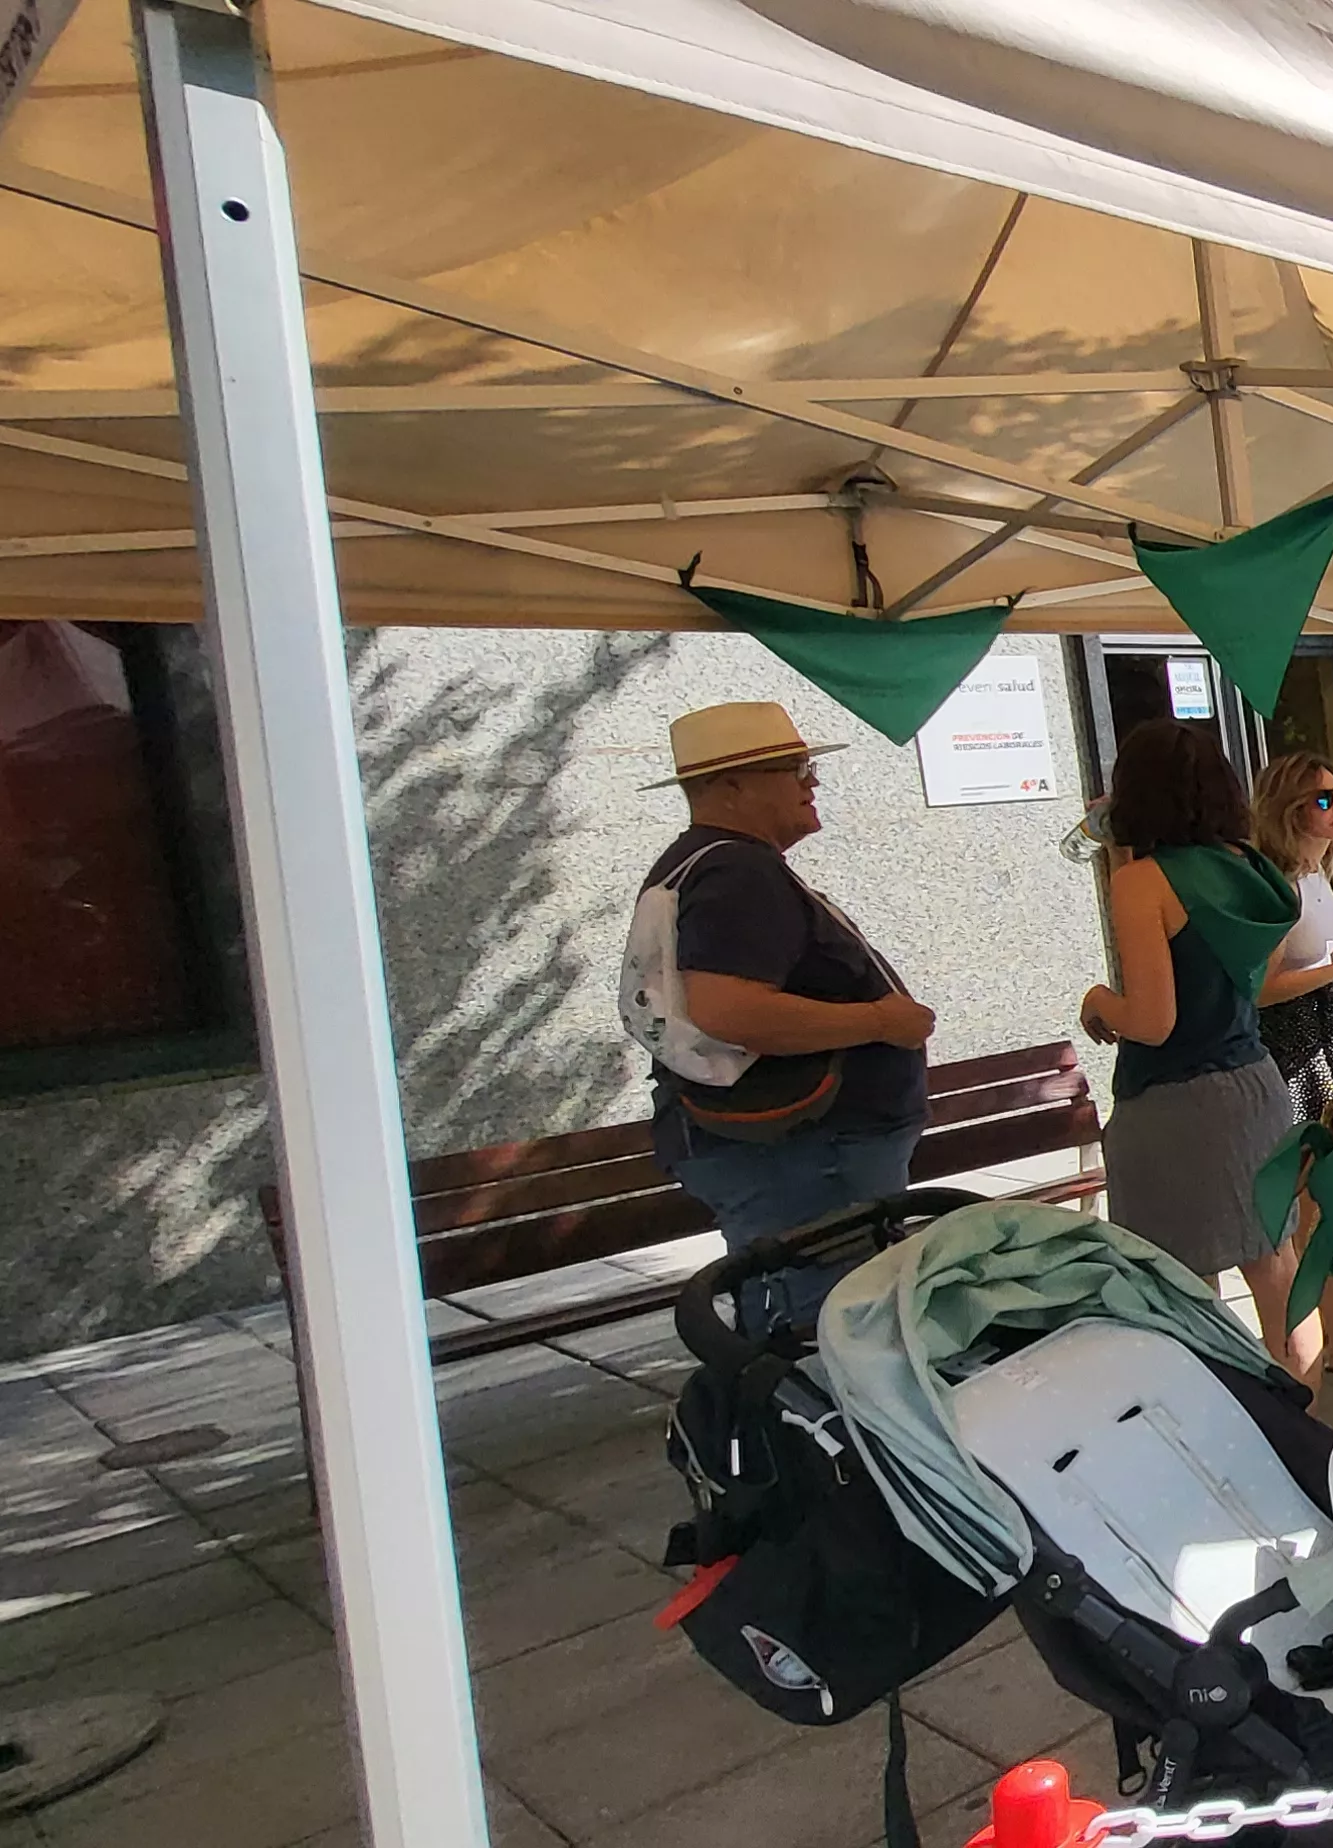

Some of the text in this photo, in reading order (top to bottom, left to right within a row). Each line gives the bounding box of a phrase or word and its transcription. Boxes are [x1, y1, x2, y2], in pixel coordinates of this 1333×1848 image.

[997, 679, 1035, 693] salud
[1012, 731, 1025, 741] DE
[953, 740, 1043, 752] RIESGOS LABORALES
